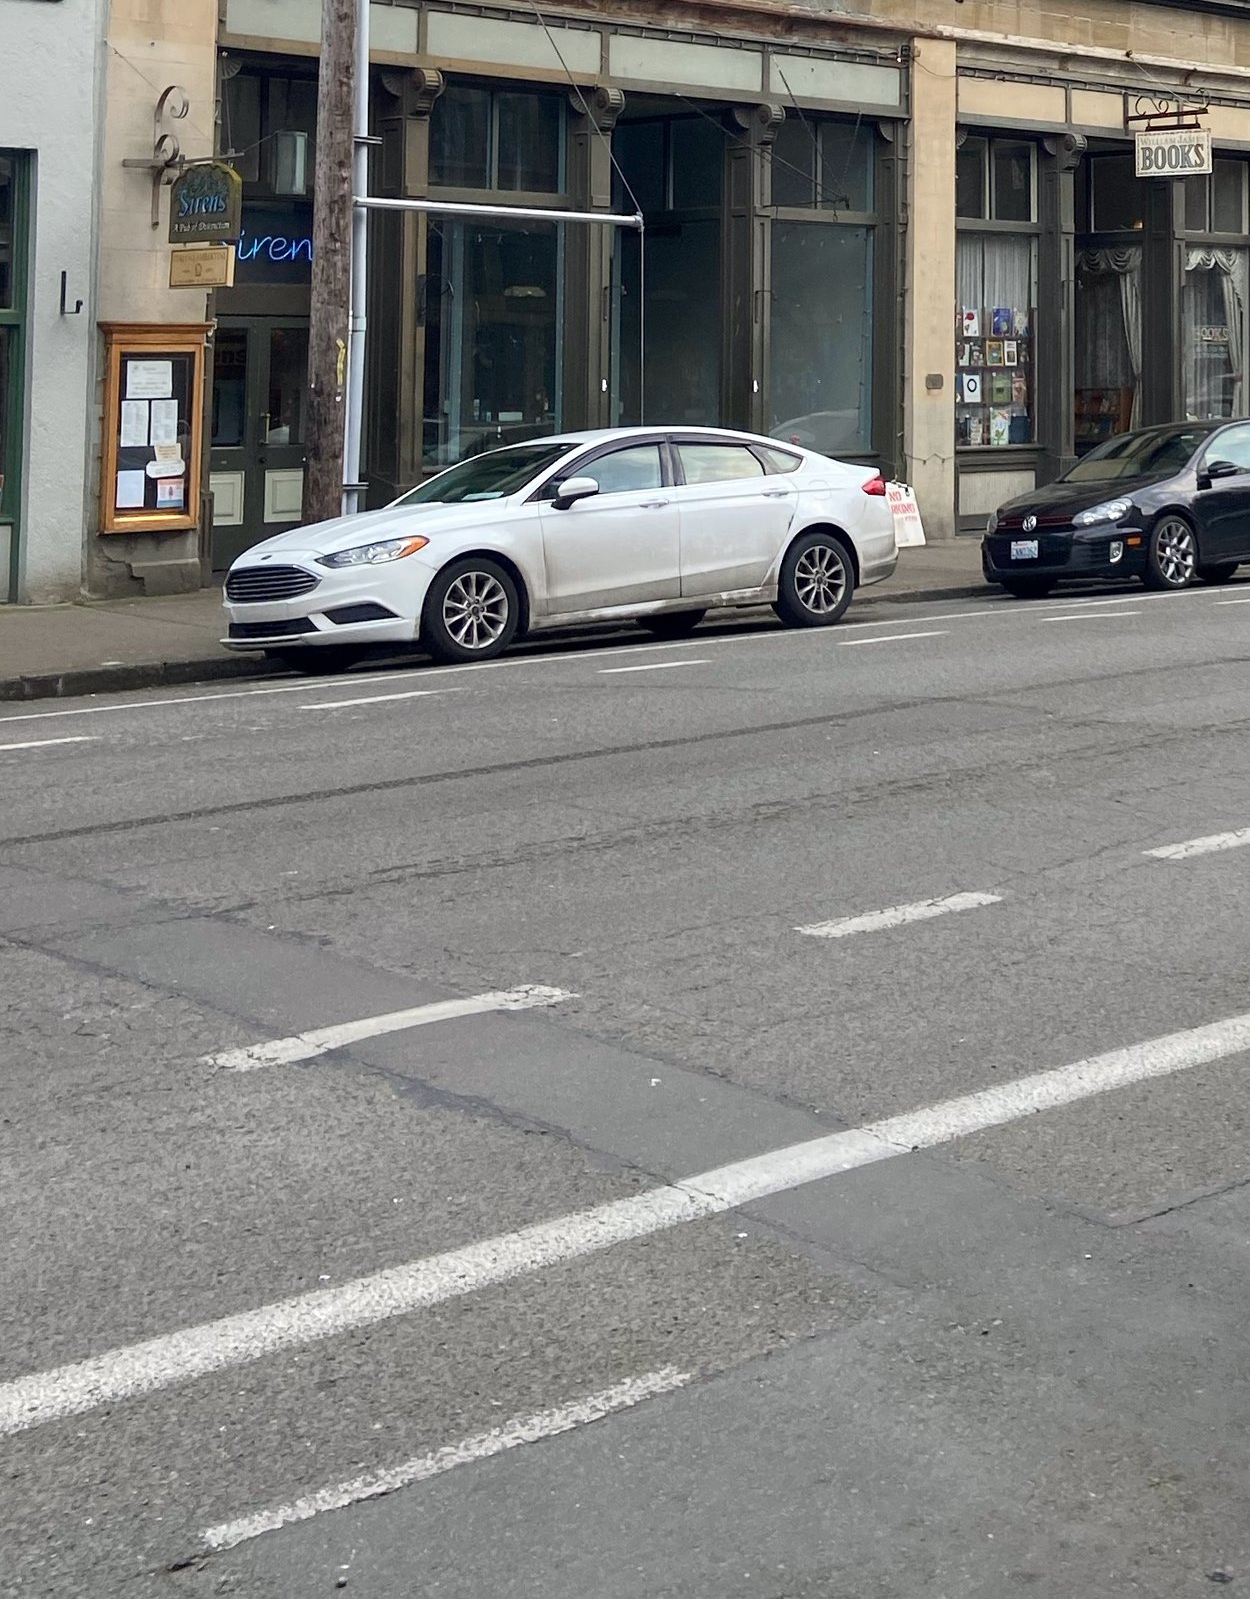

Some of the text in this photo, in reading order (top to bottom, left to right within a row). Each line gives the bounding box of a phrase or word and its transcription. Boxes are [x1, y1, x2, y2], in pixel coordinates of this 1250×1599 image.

[1141, 144, 1204, 170] BOOKS
[178, 190, 226, 216] Sirens
[237, 229, 314, 261] iren
